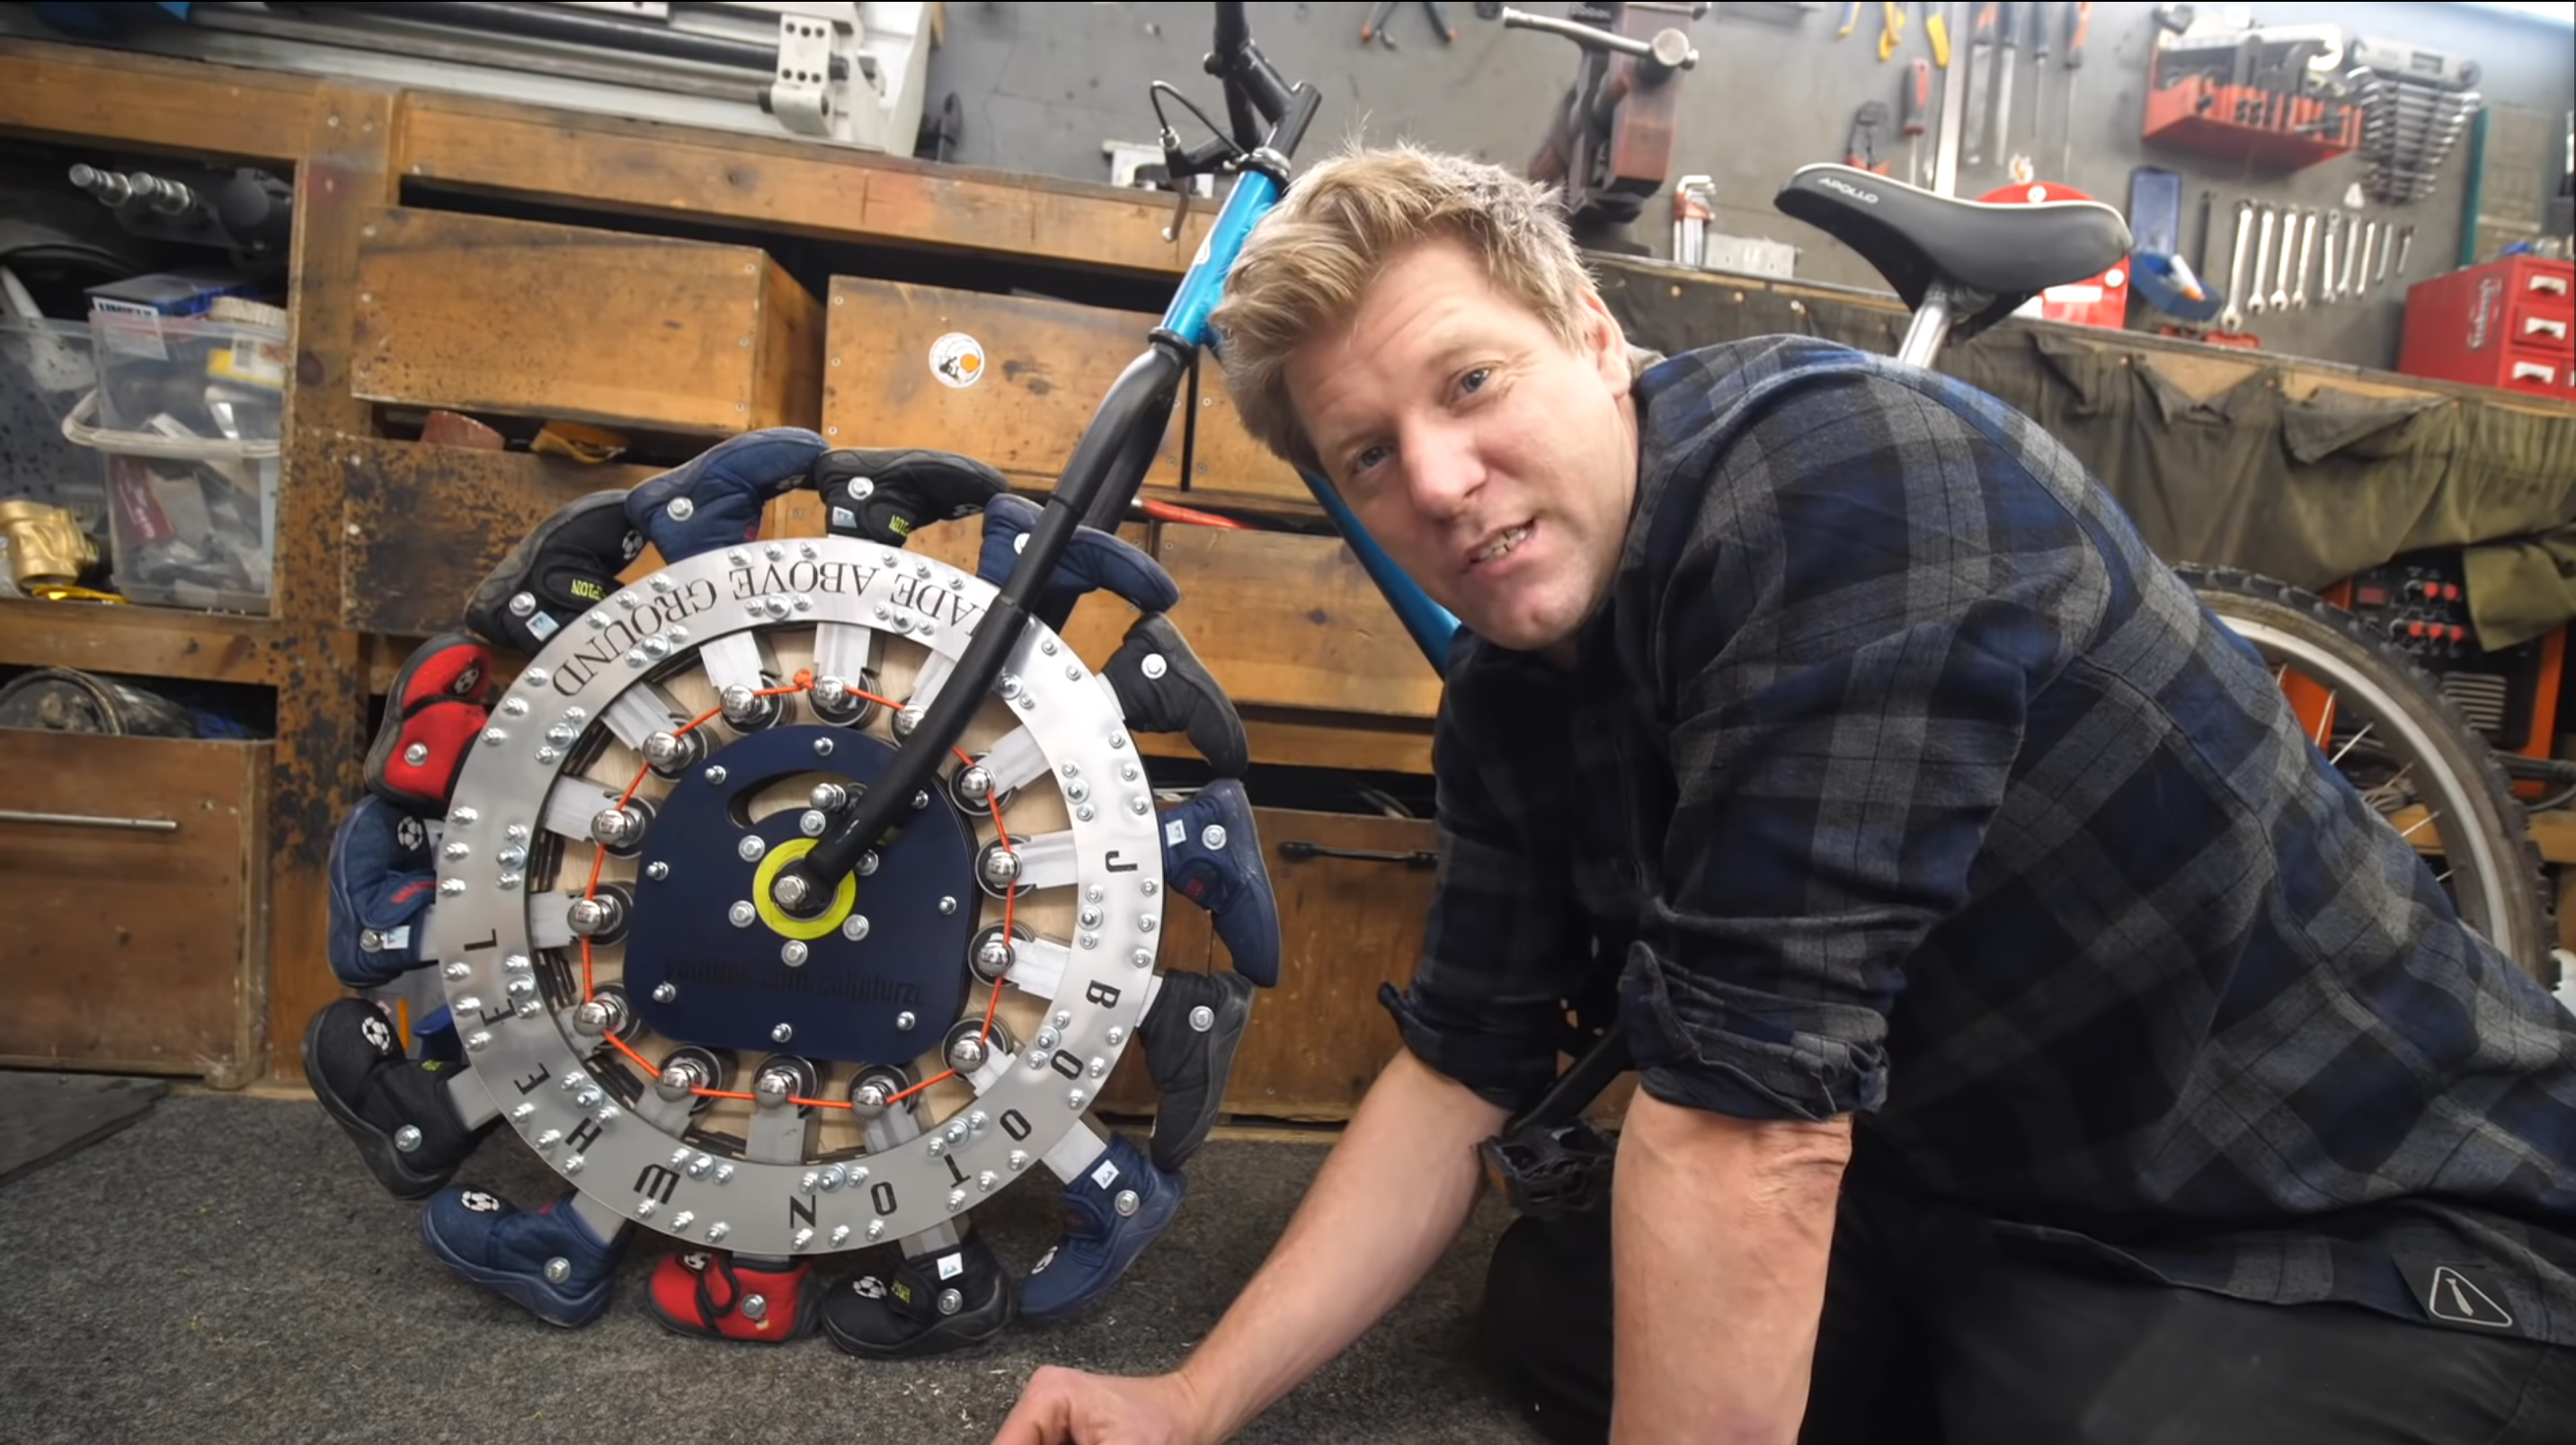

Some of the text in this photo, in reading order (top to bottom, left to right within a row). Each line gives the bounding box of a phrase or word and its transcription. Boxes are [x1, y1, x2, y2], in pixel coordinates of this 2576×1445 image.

[1817, 177, 1879, 204] APOLLO
[728, 561, 882, 600] ABOVE
[552, 578, 717, 696] GROUND
[1105, 850, 1138, 873] J
[463, 928, 680, 1204] WHEEL
